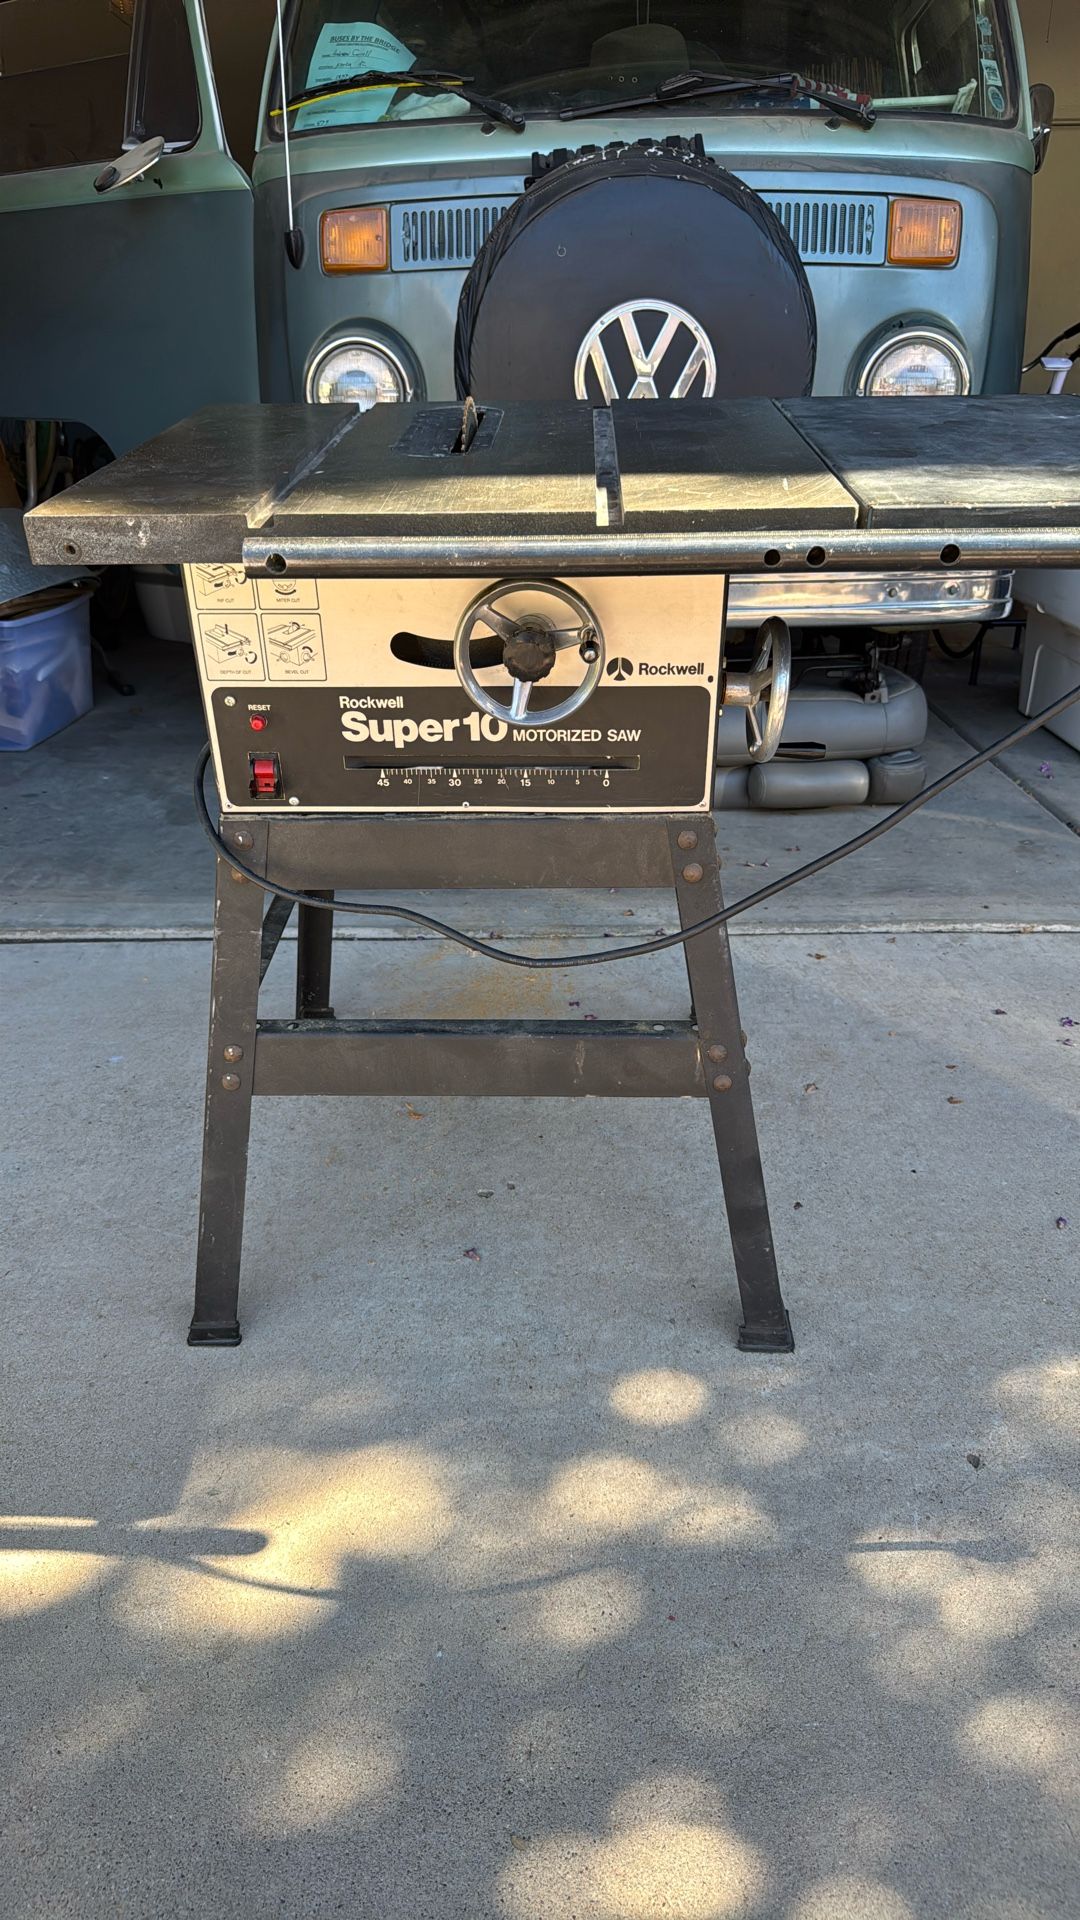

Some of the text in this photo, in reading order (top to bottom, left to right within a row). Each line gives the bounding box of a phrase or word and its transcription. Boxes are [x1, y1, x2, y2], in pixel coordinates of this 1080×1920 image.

[330, 35, 350, 43] BUSES
[374, 36, 400, 54] BRIDGE
[575, 298, 716, 403] VW
[638, 663, 704, 675] Rockwell
[338, 695, 404, 709] Rockwell
[341, 711, 641, 748] Super 10 MOTORIZED SAW
[376, 778, 390, 787] 45
[448, 779, 461, 787] 30
[520, 779, 531, 787] 15
[602, 779, 610, 787] 0
